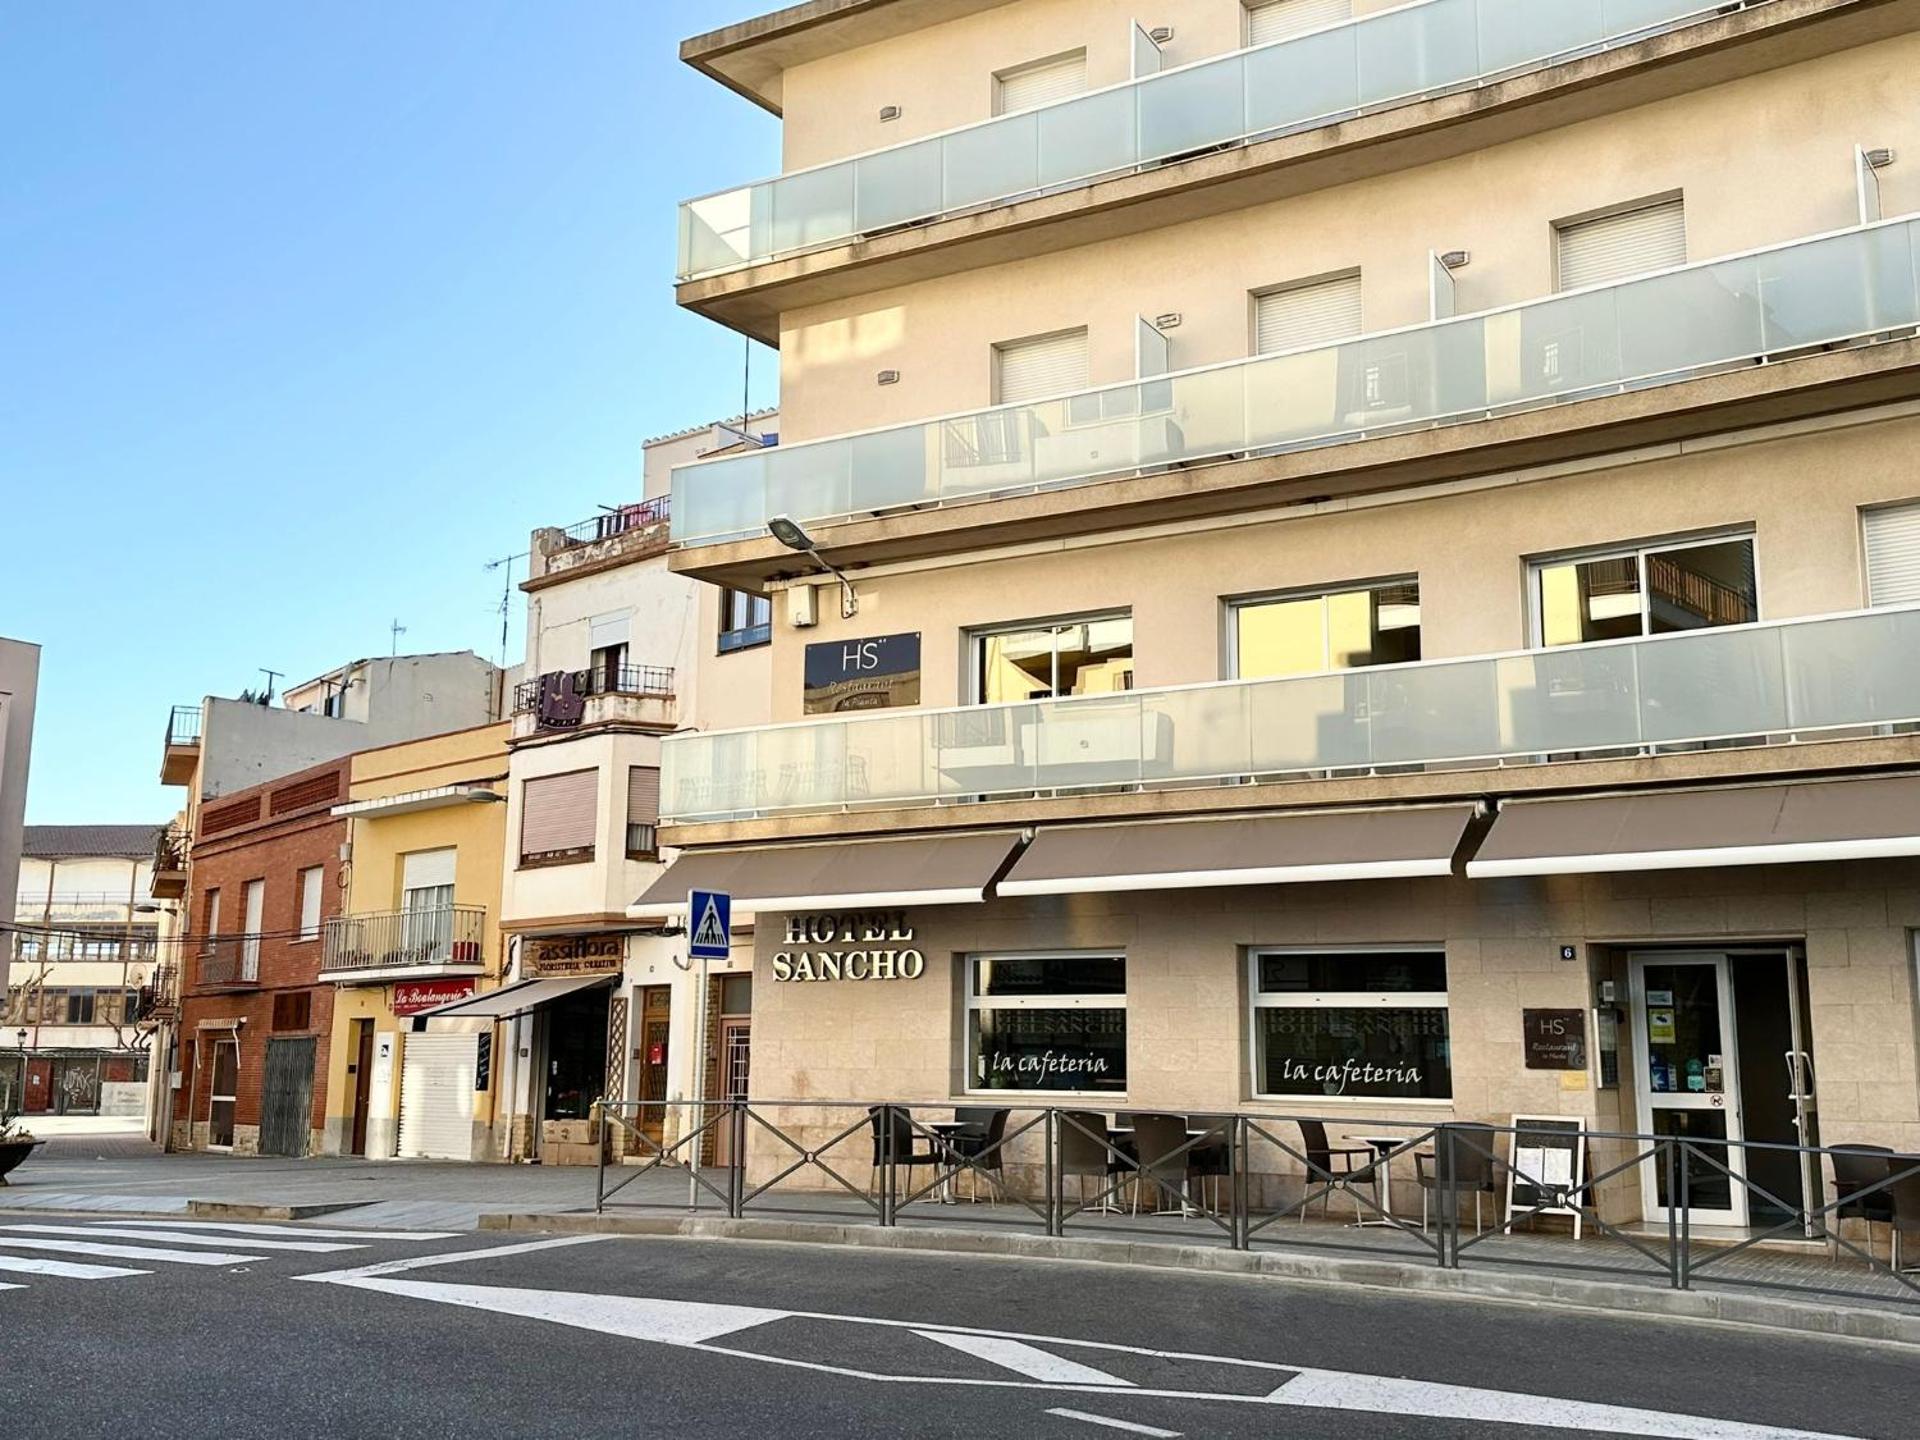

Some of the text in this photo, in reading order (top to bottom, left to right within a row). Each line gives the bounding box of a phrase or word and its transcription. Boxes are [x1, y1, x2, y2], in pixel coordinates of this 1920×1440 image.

[782, 911, 914, 945] HOTEL
[772, 949, 924, 981] SANCHO
[1563, 947, 1572, 959] 6
[1540, 1018, 1565, 1035] HS
[992, 1050, 1109, 1085] la cafeteria
[1283, 1058, 1423, 1095] la cafeteria
